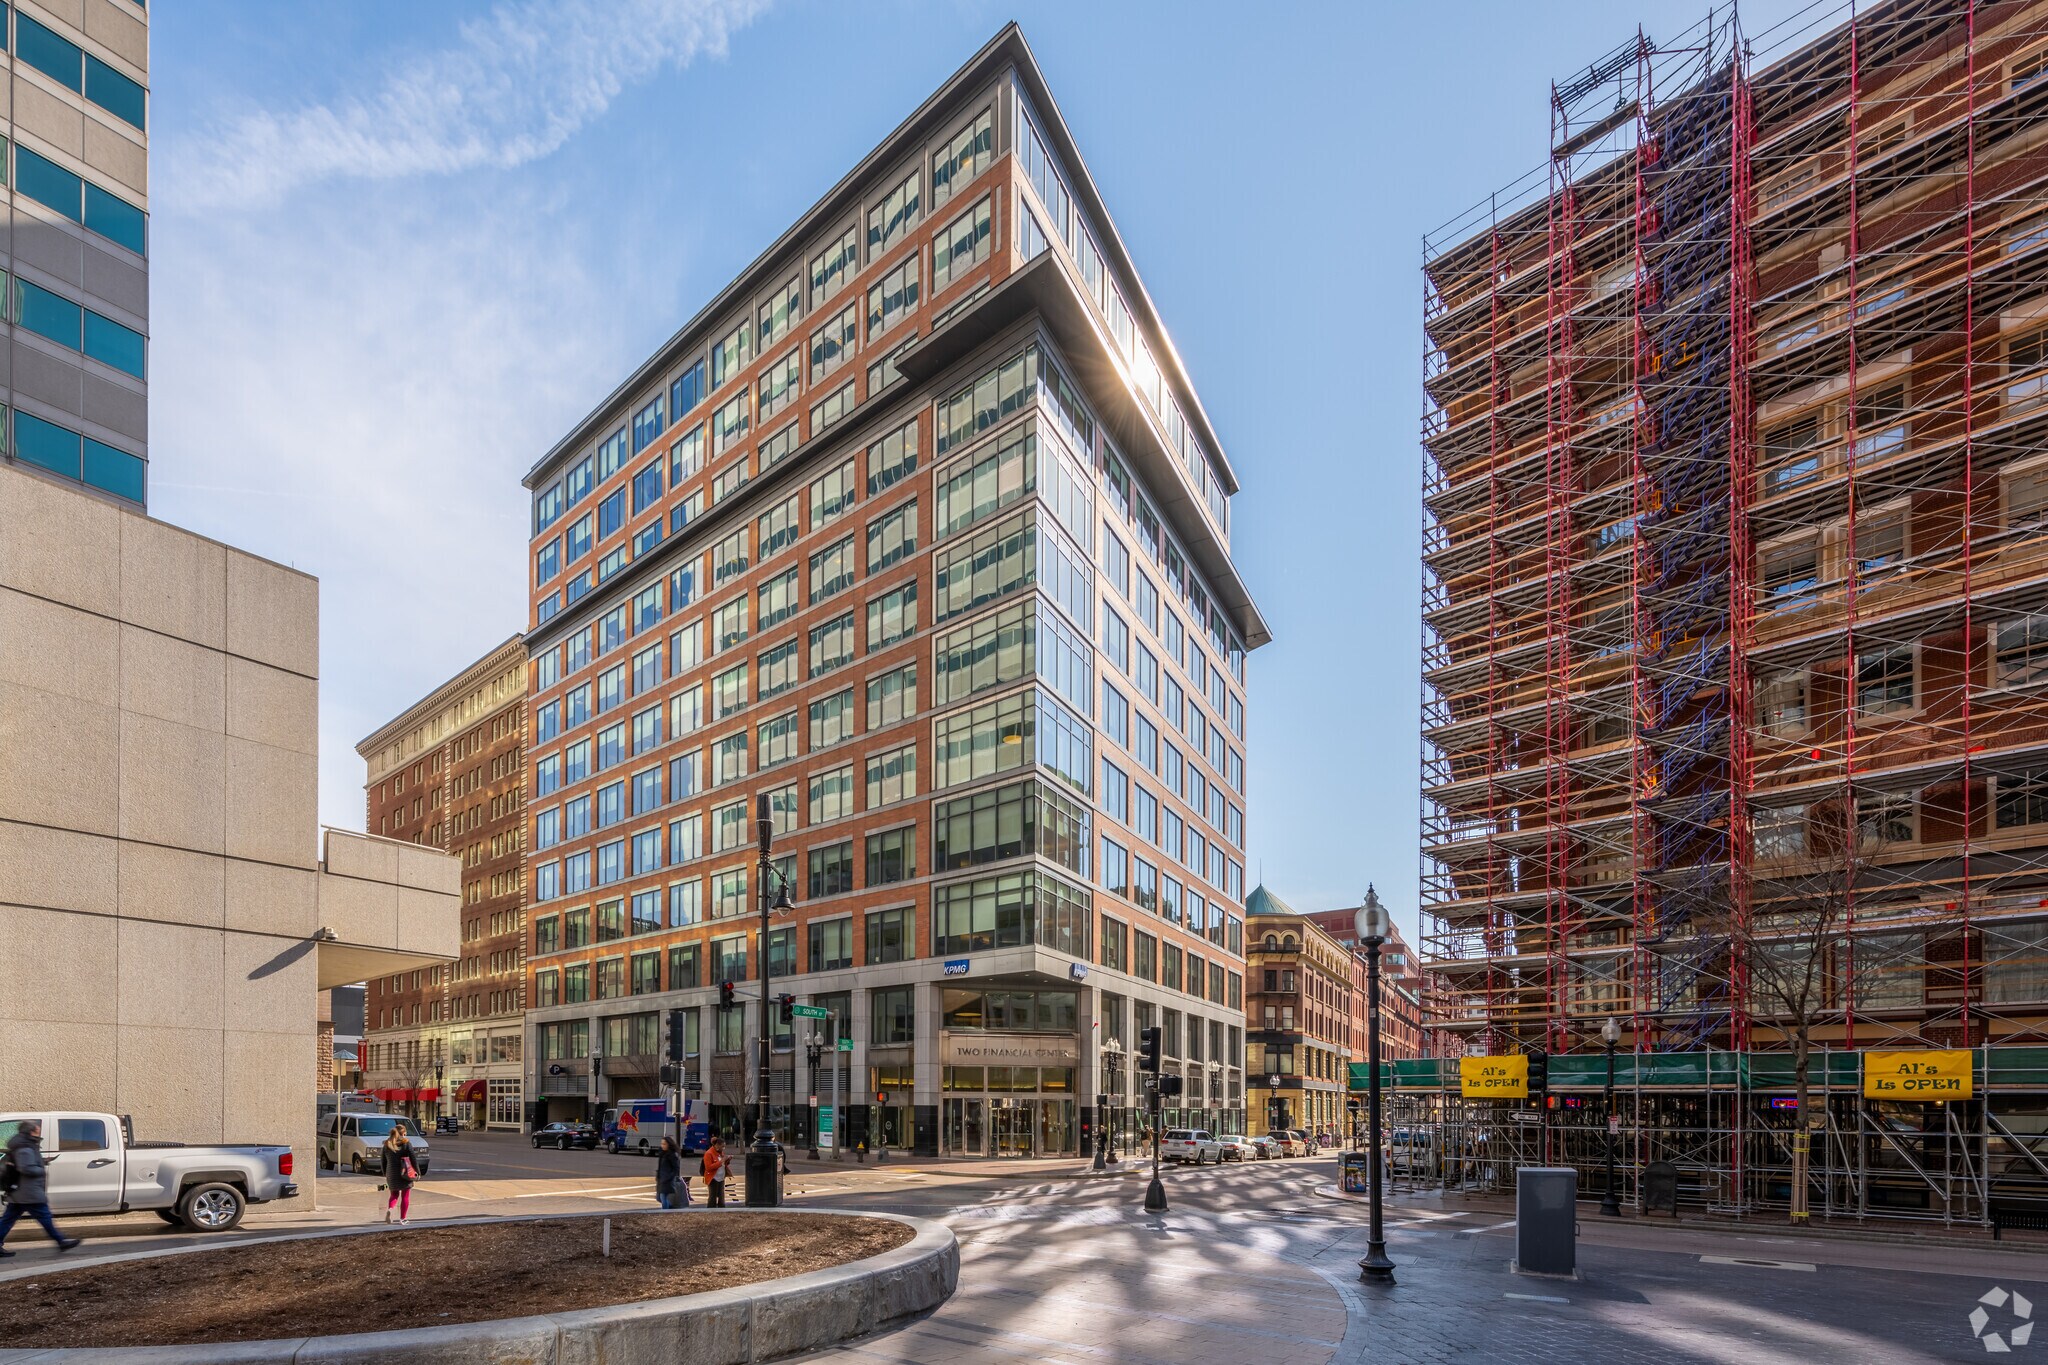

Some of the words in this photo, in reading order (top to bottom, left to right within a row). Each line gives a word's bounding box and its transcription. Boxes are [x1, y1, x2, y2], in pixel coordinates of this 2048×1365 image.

[943, 964, 967, 975] KPMG
[957, 1047, 980, 1056] TWO
[983, 1048, 1033, 1057] FINANCIAL
[1481, 1067, 1507, 1076] Al's
[1897, 1063, 1938, 1075] Al's
[1484, 1078, 1520, 1088] OPEN
[1875, 1079, 1896, 1090] Is
[1903, 1078, 1961, 1091] OPEN
